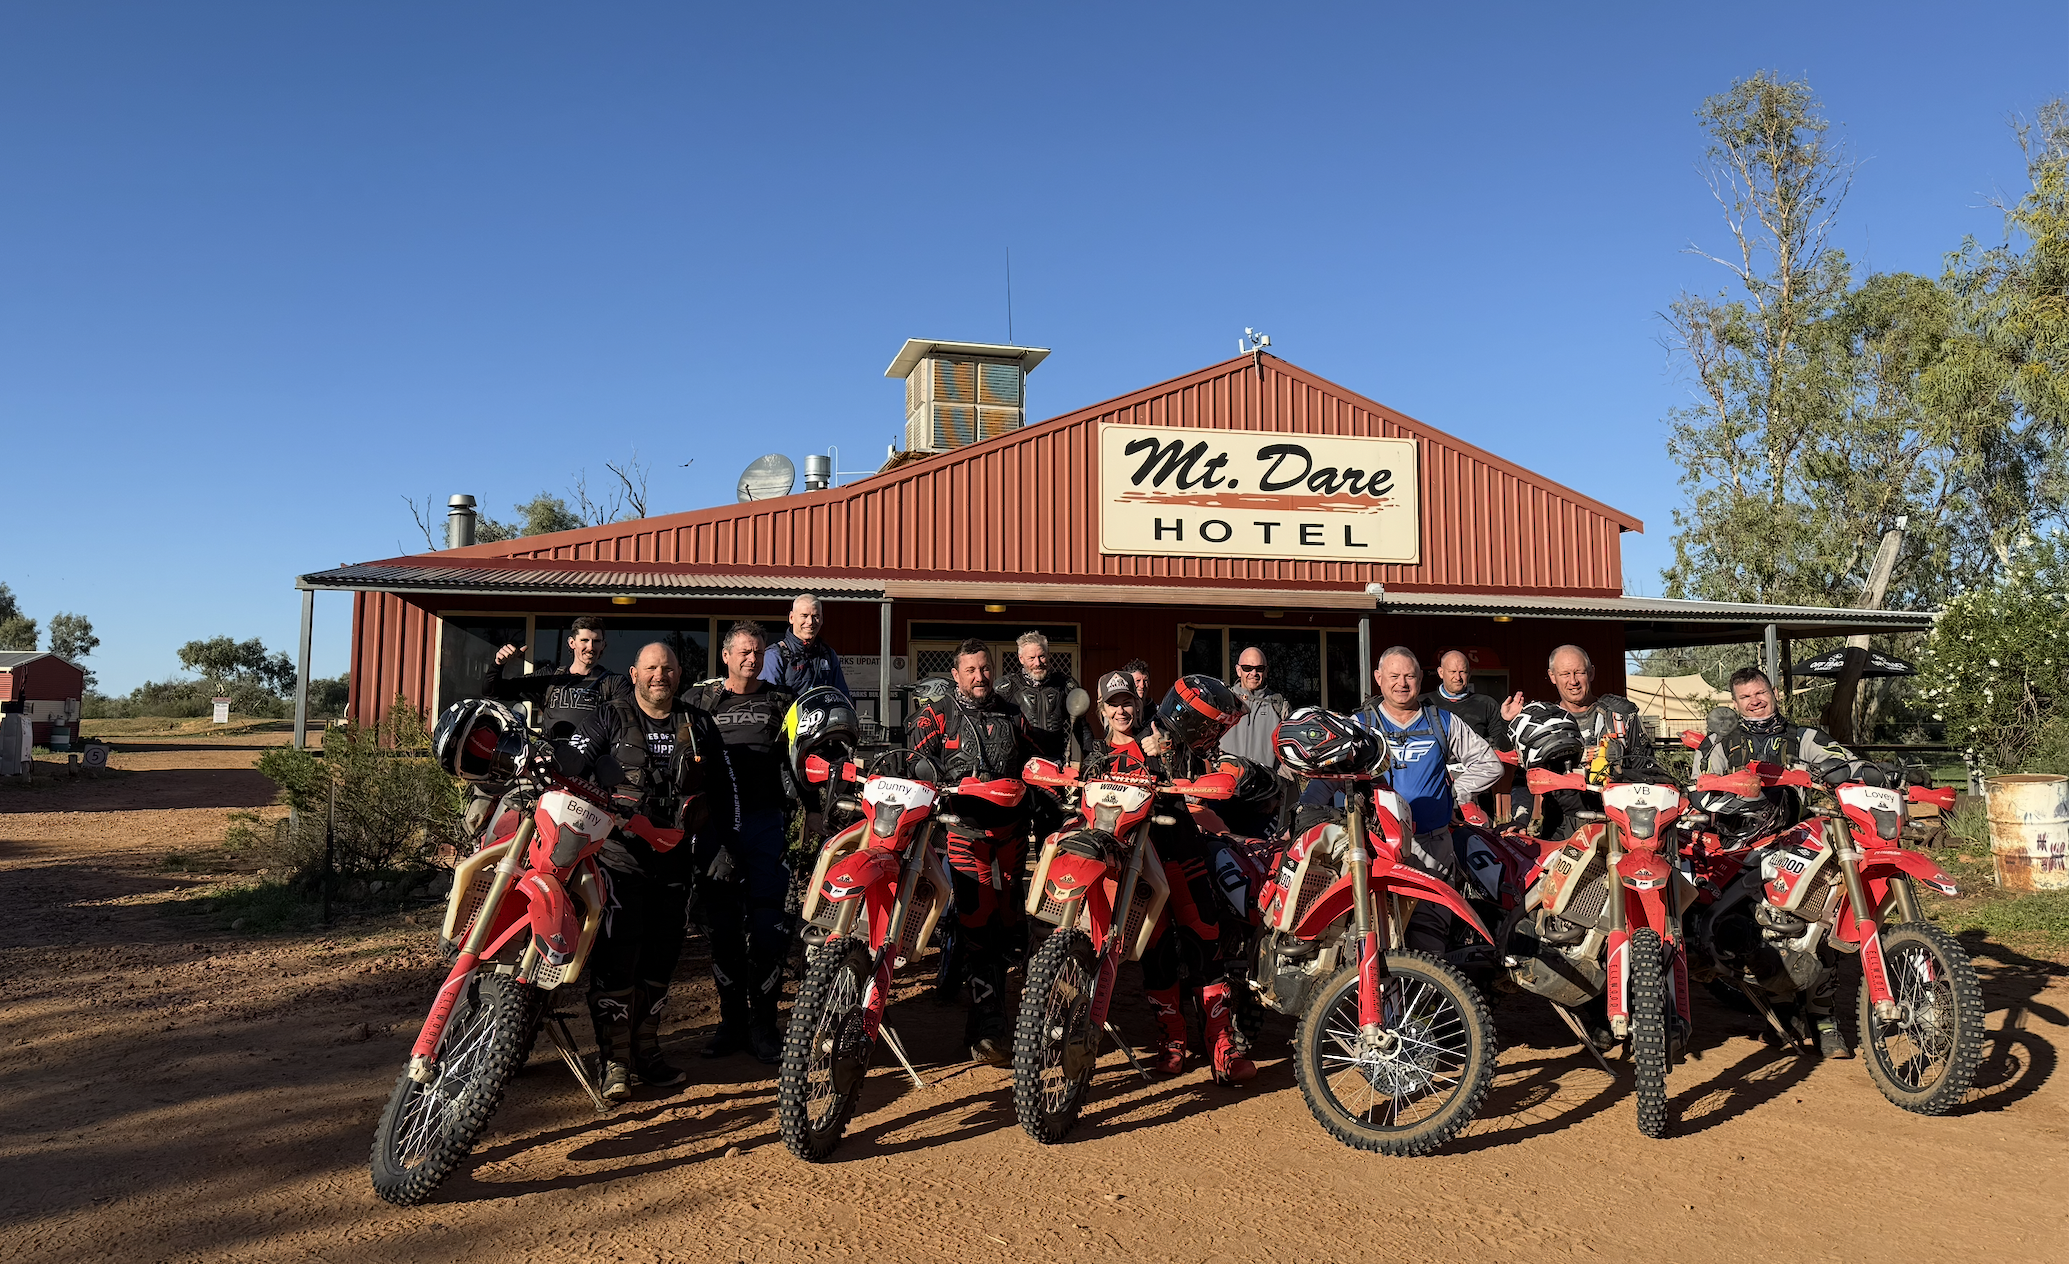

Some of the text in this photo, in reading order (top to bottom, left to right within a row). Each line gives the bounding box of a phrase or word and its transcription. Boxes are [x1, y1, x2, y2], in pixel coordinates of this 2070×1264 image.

[1124, 437, 1395, 496] Mt. Dare
[1153, 517, 1369, 548] HOTEL
[856, 657, 880, 665] UPDAT
[92, 751, 99, 761] 5
[877, 780, 912, 796] Dunny
[1633, 786, 1651, 795] VB
[1864, 789, 1895, 803] Lovey
[566, 800, 601, 827] Benny
[426, 992, 455, 1045] ELLWOOD
